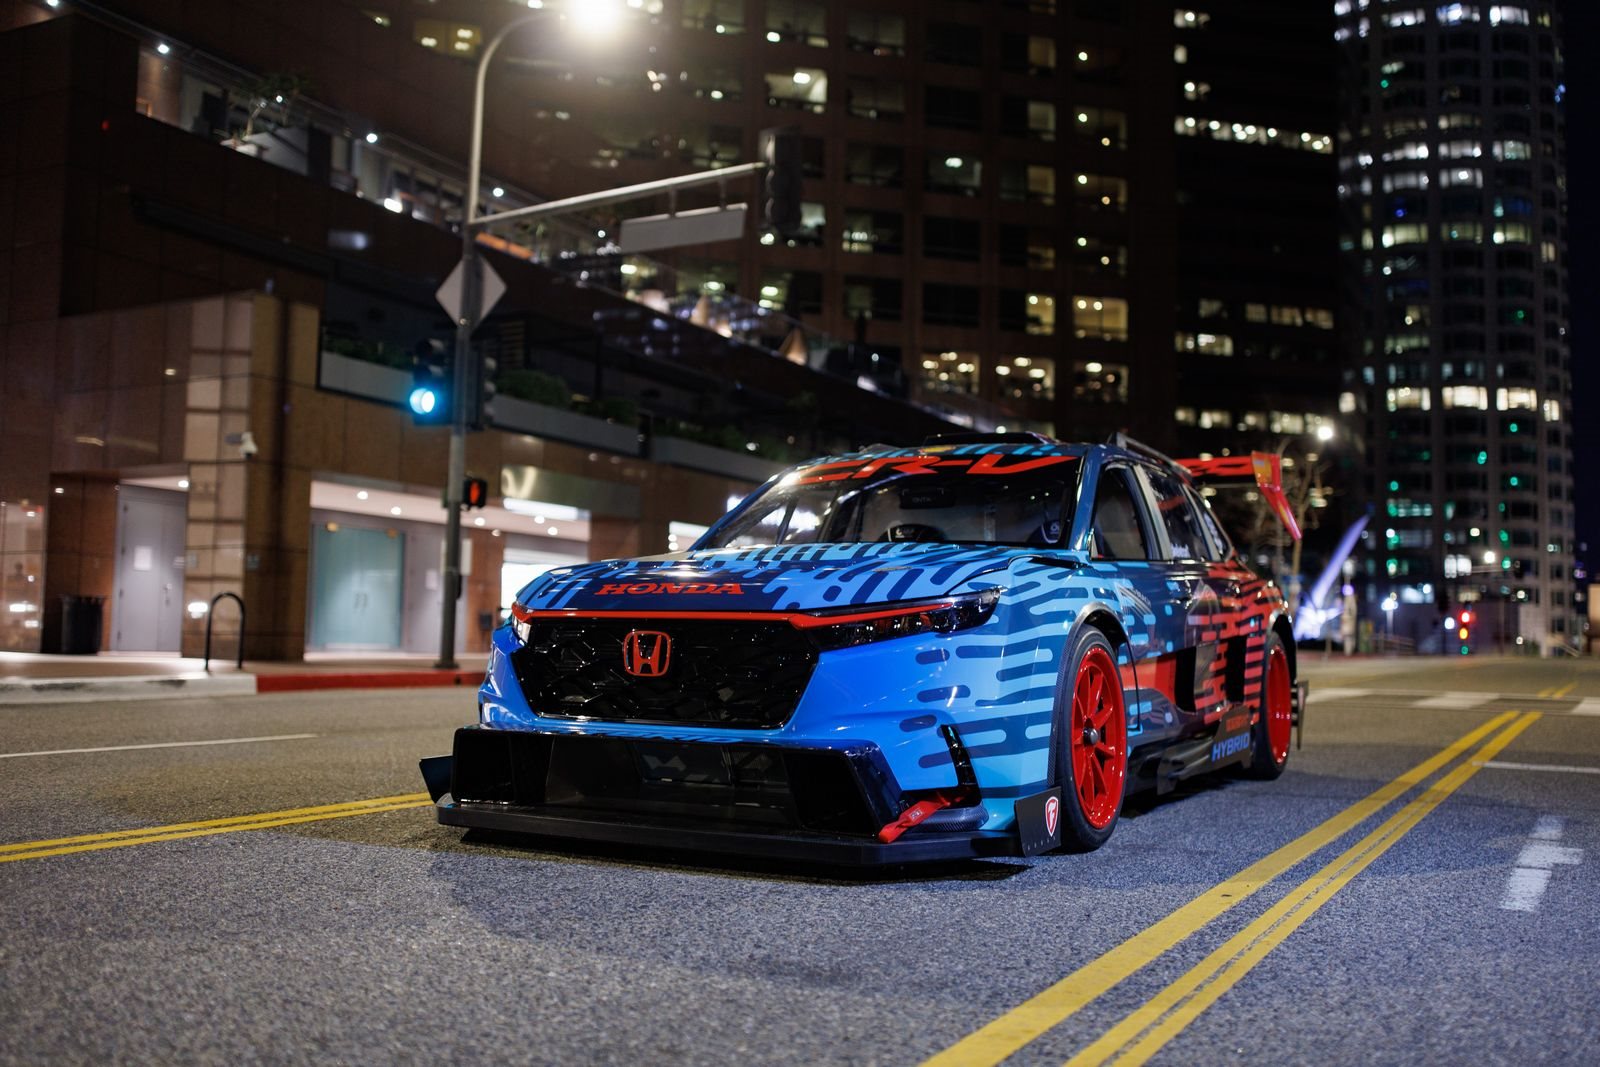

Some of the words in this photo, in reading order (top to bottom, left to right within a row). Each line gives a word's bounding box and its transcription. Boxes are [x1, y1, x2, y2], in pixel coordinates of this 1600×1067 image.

[796, 453, 1078, 485] CR-V
[594, 582, 744, 595] HONDA
[1211, 732, 1250, 762] HYBRID
